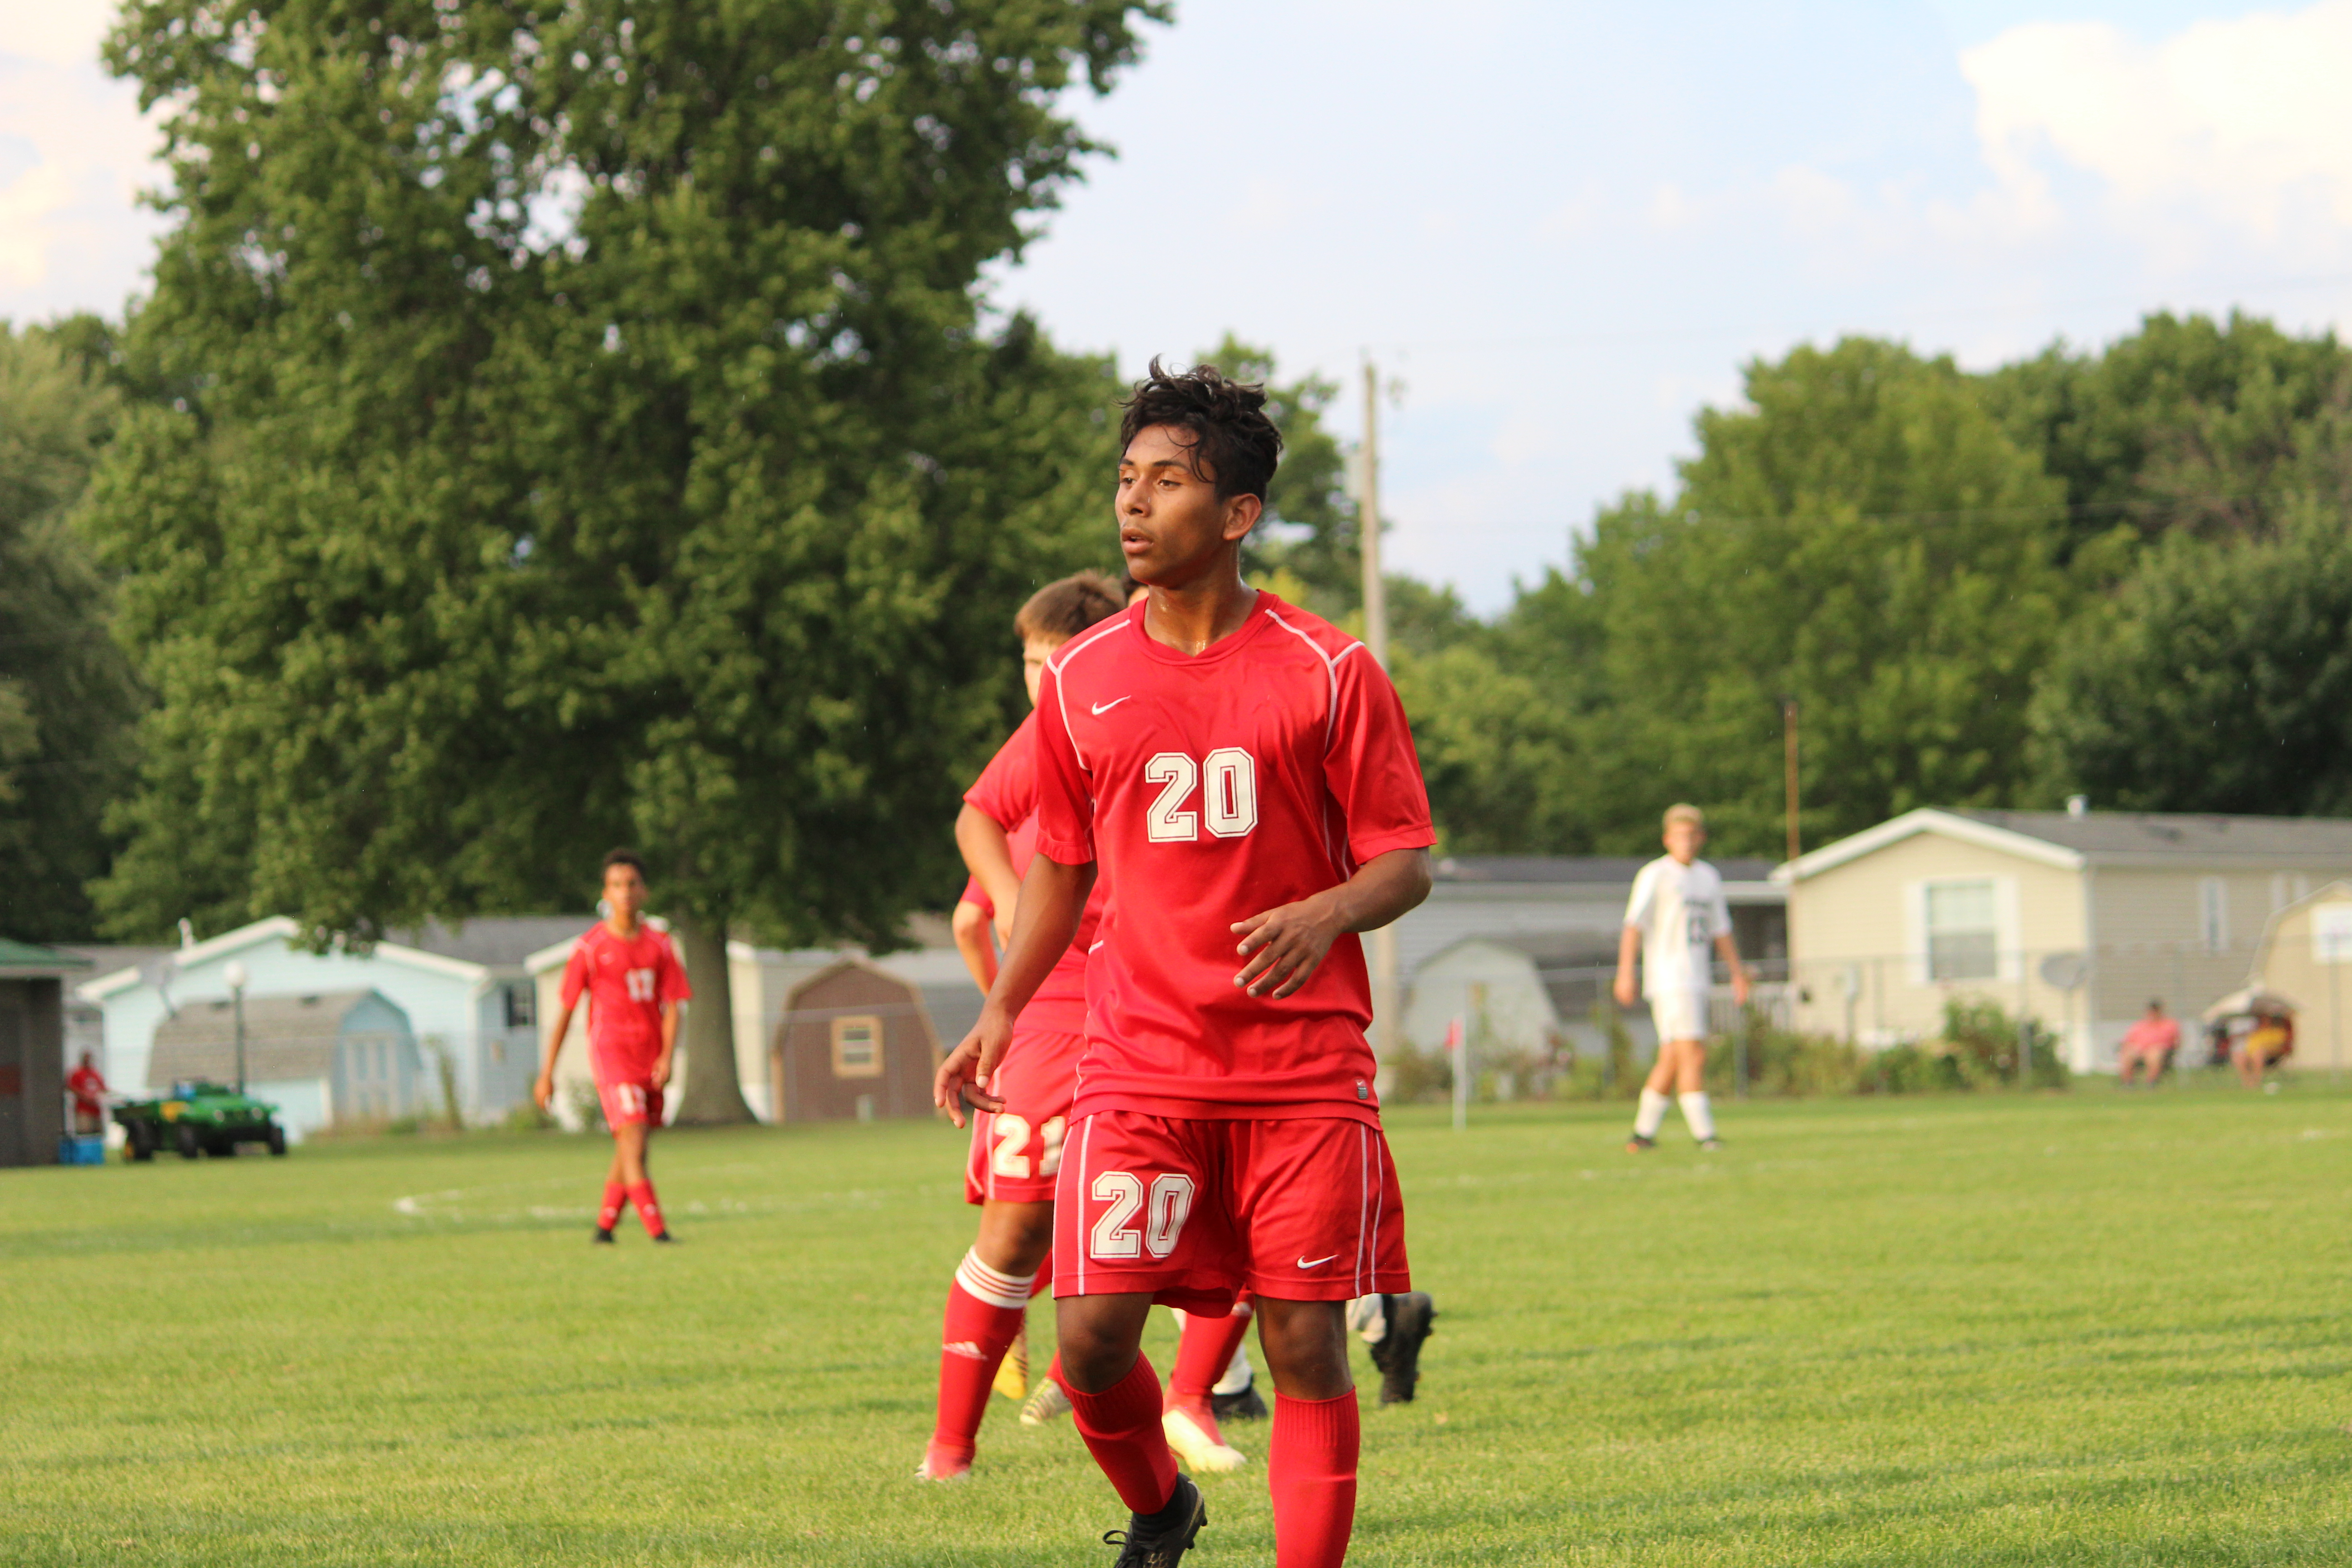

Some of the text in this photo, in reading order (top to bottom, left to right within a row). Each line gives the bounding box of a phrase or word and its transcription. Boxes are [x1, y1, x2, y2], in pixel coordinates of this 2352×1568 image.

[1145, 747, 1258, 843] 20
[993, 1113, 1066, 1179] 21
[1090, 1171, 1196, 1258] 20
